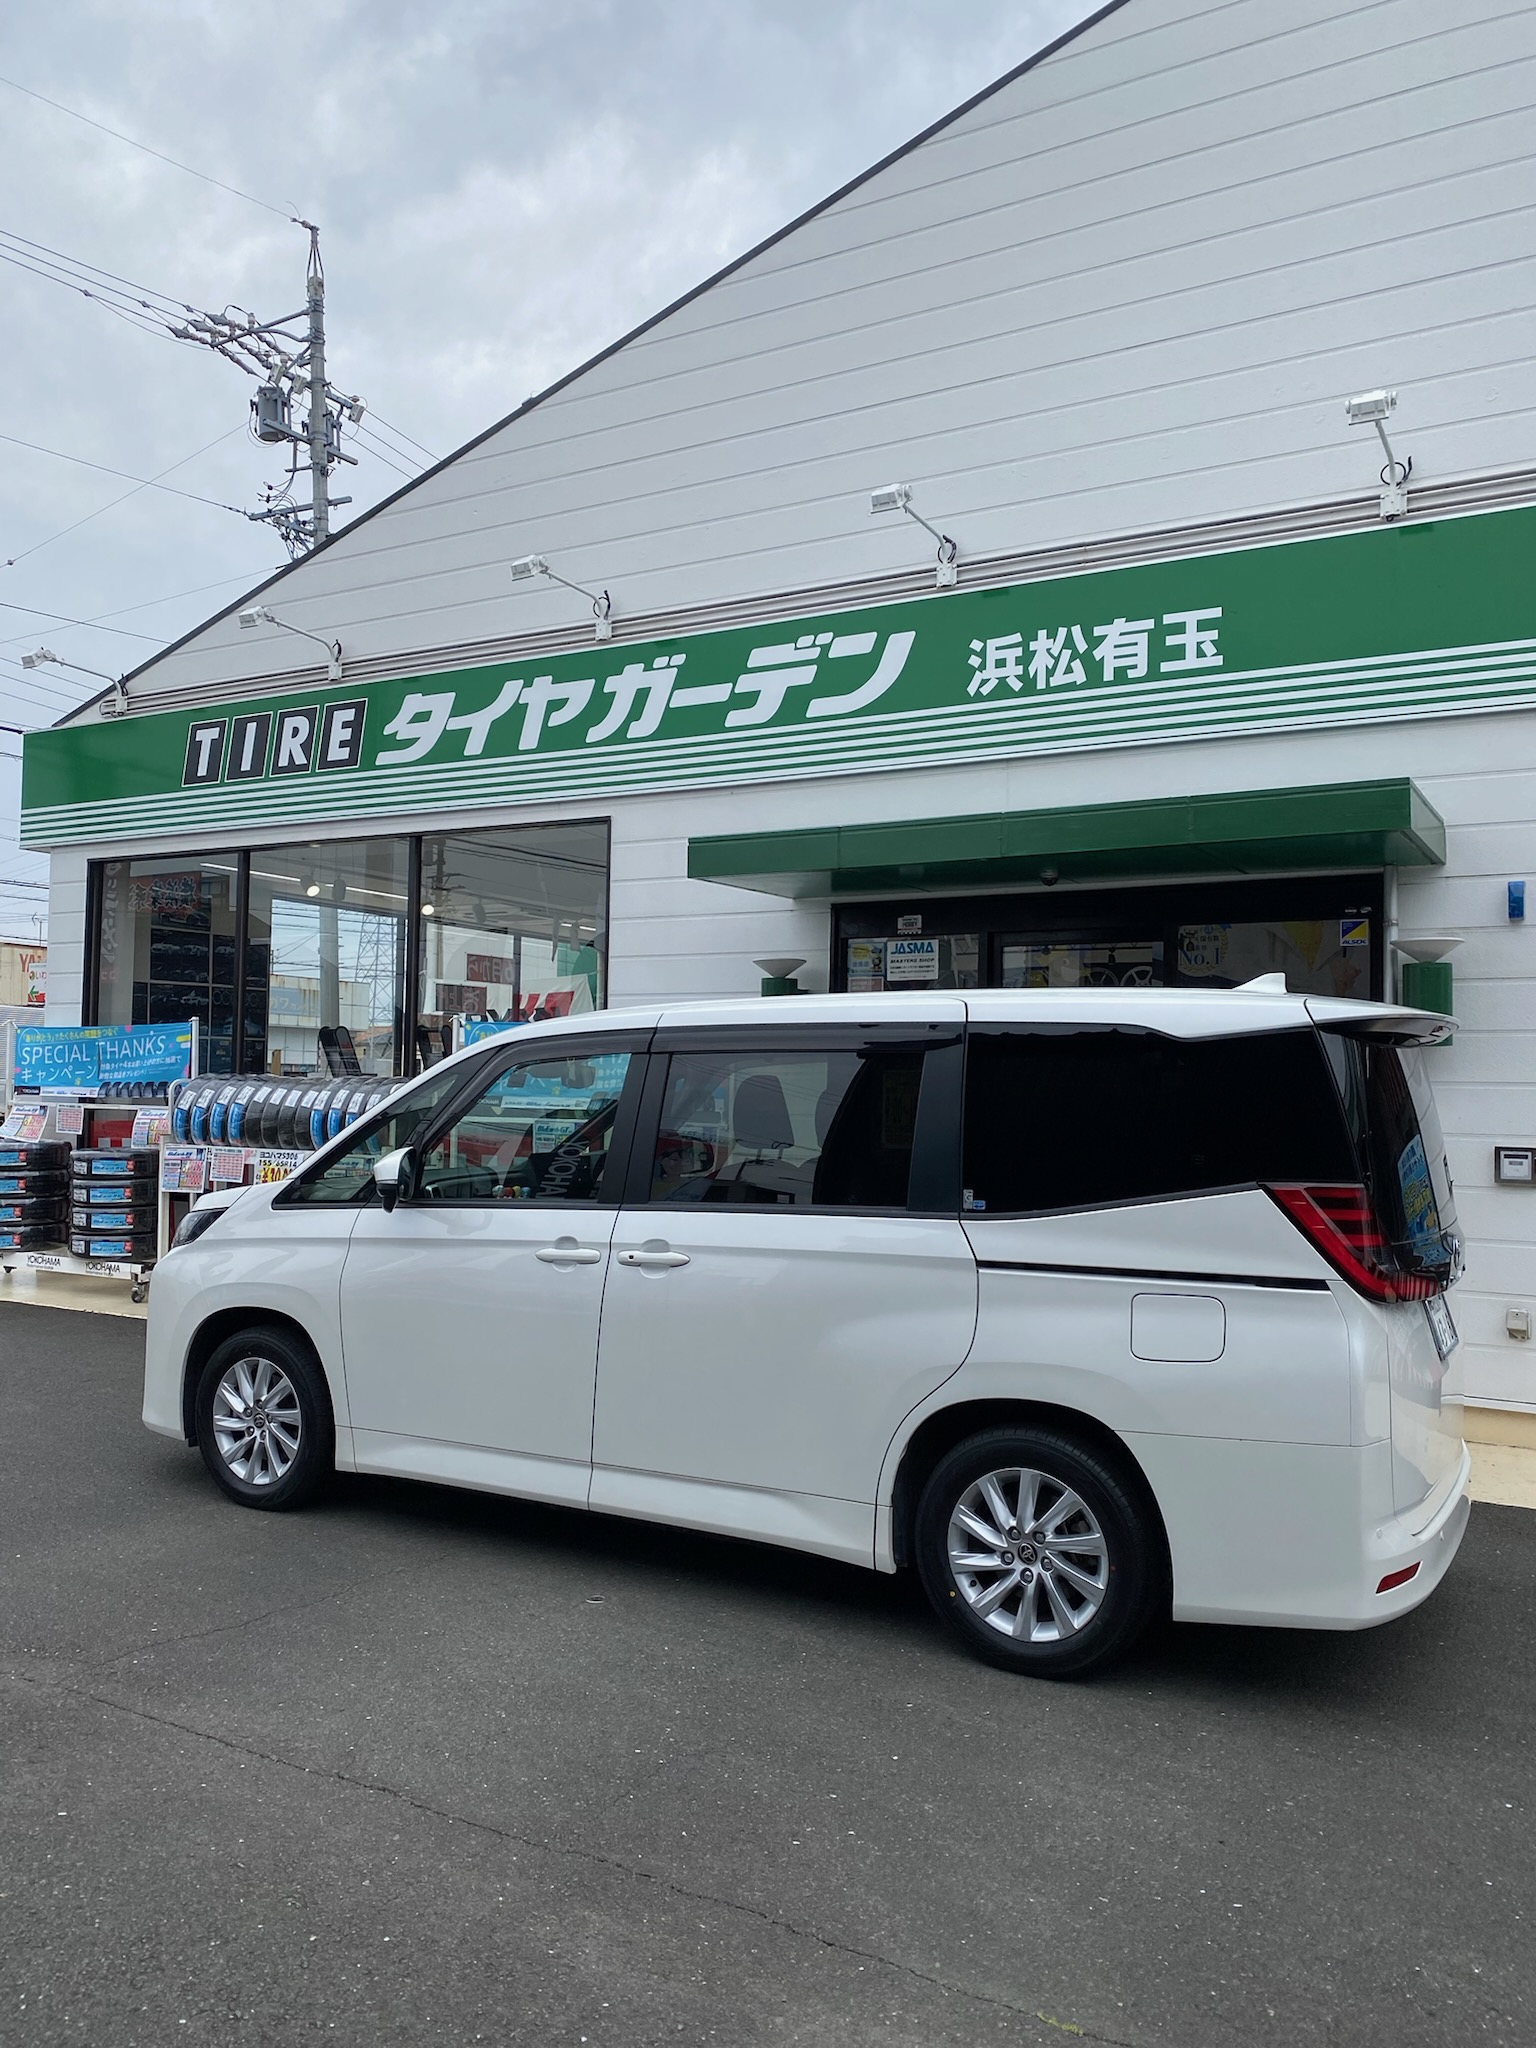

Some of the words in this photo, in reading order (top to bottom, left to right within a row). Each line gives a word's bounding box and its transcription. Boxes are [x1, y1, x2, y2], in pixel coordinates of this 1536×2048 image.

[190, 708, 358, 780] TIRE
[375, 630, 916, 765] タイヤガーデン
[966, 607, 1224, 697] 浜松有玉
[890, 941, 934, 954] JASMA
[21, 1042, 91, 1065] SPECIAL
[95, 1036, 166, 1060] THANKS
[21, 1066, 97, 1083] キャンペーン
[27, 1255, 61, 1267] YOKOHAMA
[85, 1261, 121, 1273] YOKOHAMA
